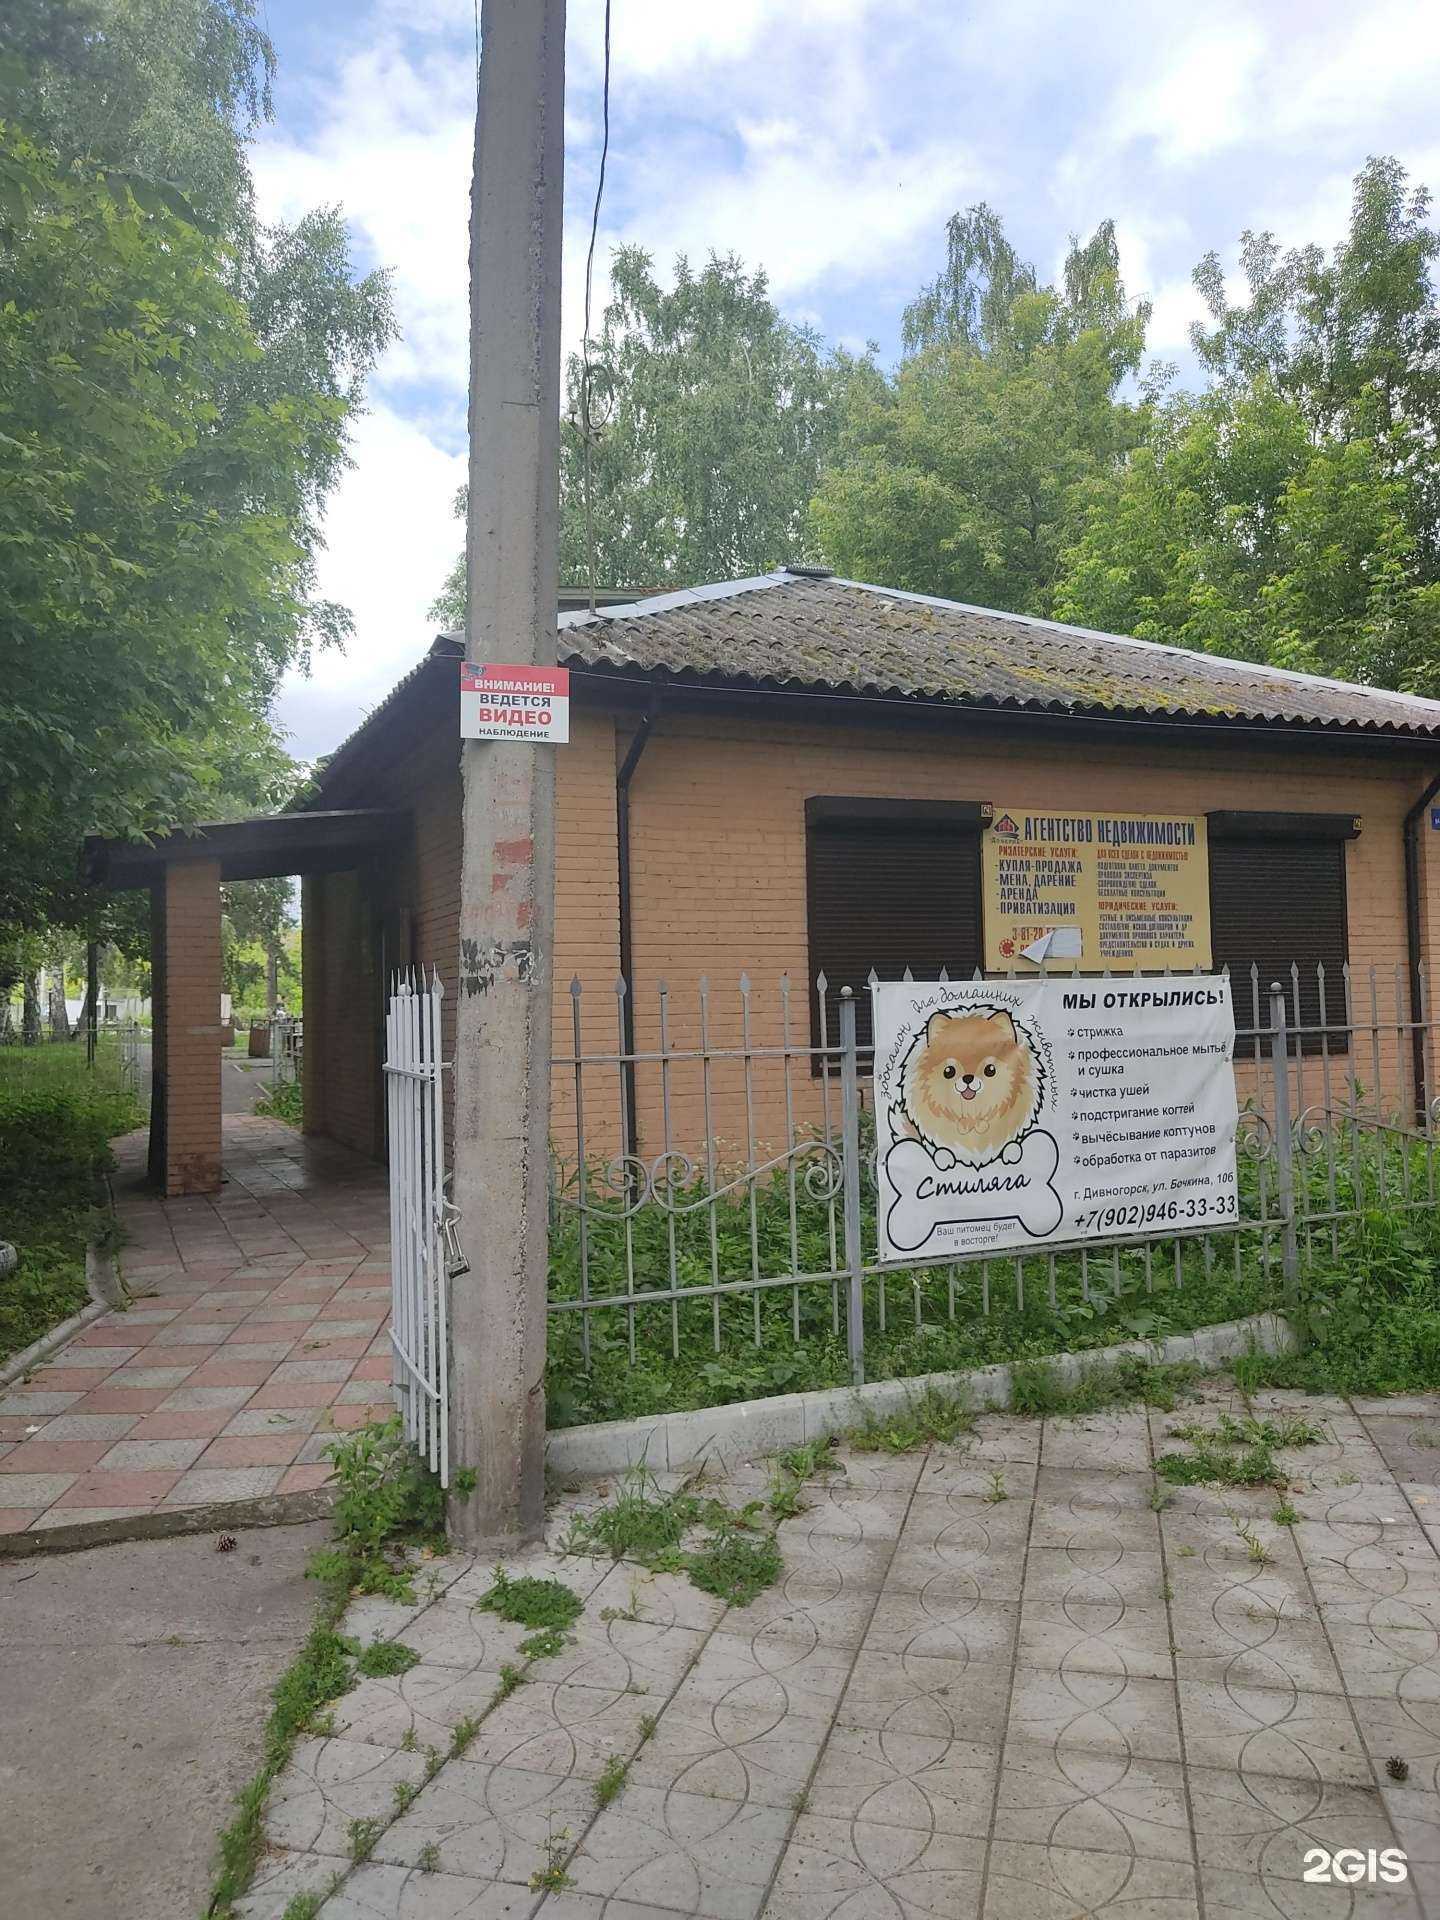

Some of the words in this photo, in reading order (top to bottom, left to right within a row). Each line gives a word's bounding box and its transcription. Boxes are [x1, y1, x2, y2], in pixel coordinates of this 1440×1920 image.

[474, 679, 555, 693] ВНИМАНИЕ!
[480, 694, 551, 707] ВЕДЕТСЯ
[479, 708, 552, 726] ВИДЕО
[479, 728, 550, 738] НАБЛЮДЕНИЕ
[1024, 817, 1093, 843] АГЕНТСТВО
[1097, 820, 1196, 848] НЕДВИЖИМОСТИ
[999, 873, 1032, 888] МЕНА,
[1034, 875, 1077, 889] ДАРЕНИЕ
[1000, 887, 1039, 902] АРЕНДА
[1000, 901, 1076, 917] ПРИВАТИЗАЦИЯ
[1098, 901, 1147, 911] ЮРИДИЧЕСКИЕ
[1062, 993, 1097, 1010] МЫ
[1103, 989, 1224, 1009] ОТКРЫЛИСЬ!
[1077, 1026, 1124, 1040] стрижка
[880, 1021, 912, 1100] зоосалон
[911, 1000, 938, 1014] для
[938, 986, 1025, 1008] домашних
[1026, 1014, 1059, 1114] животных
[1078, 1046, 1189, 1062] профессиональное
[1192, 1041, 1226, 1055] мытьё
[1078, 1066, 1085, 1076] и
[1088, 1063, 1124, 1078] сушка
[1079, 1086, 1117, 1099] чистка
[1119, 1082, 1150, 1098] ушей
[1080, 1106, 1160, 1122] подстригание
[1162, 1102, 1195, 1116] когтей
[1081, 1128, 1161, 1144] вычёсывание
[1163, 1124, 1216, 1138] колтунов
[1082, 1152, 1142, 1168] обработка
[1144, 1152, 1157, 1162] от
[1160, 1145, 1217, 1161] паразитов
[916, 1174, 1031, 1200] Стиляга
[1074, 1190, 1081, 1200] г.
[1083, 1182, 1150, 1200] Дивногорск,
[1151, 1181, 1168, 1195] ул.
[1170, 1176, 1213, 1190] Бочкина,
[1074, 1195, 1236, 1232] +7(902)946-33-33
[936, 1227, 955, 1236] Ваш
[957, 1224, 991, 1235] питомец
[993, 1221, 1017, 1233] будет
[954, 1239, 959, 1247] в
[961, 1233, 999, 1246] восторге!
